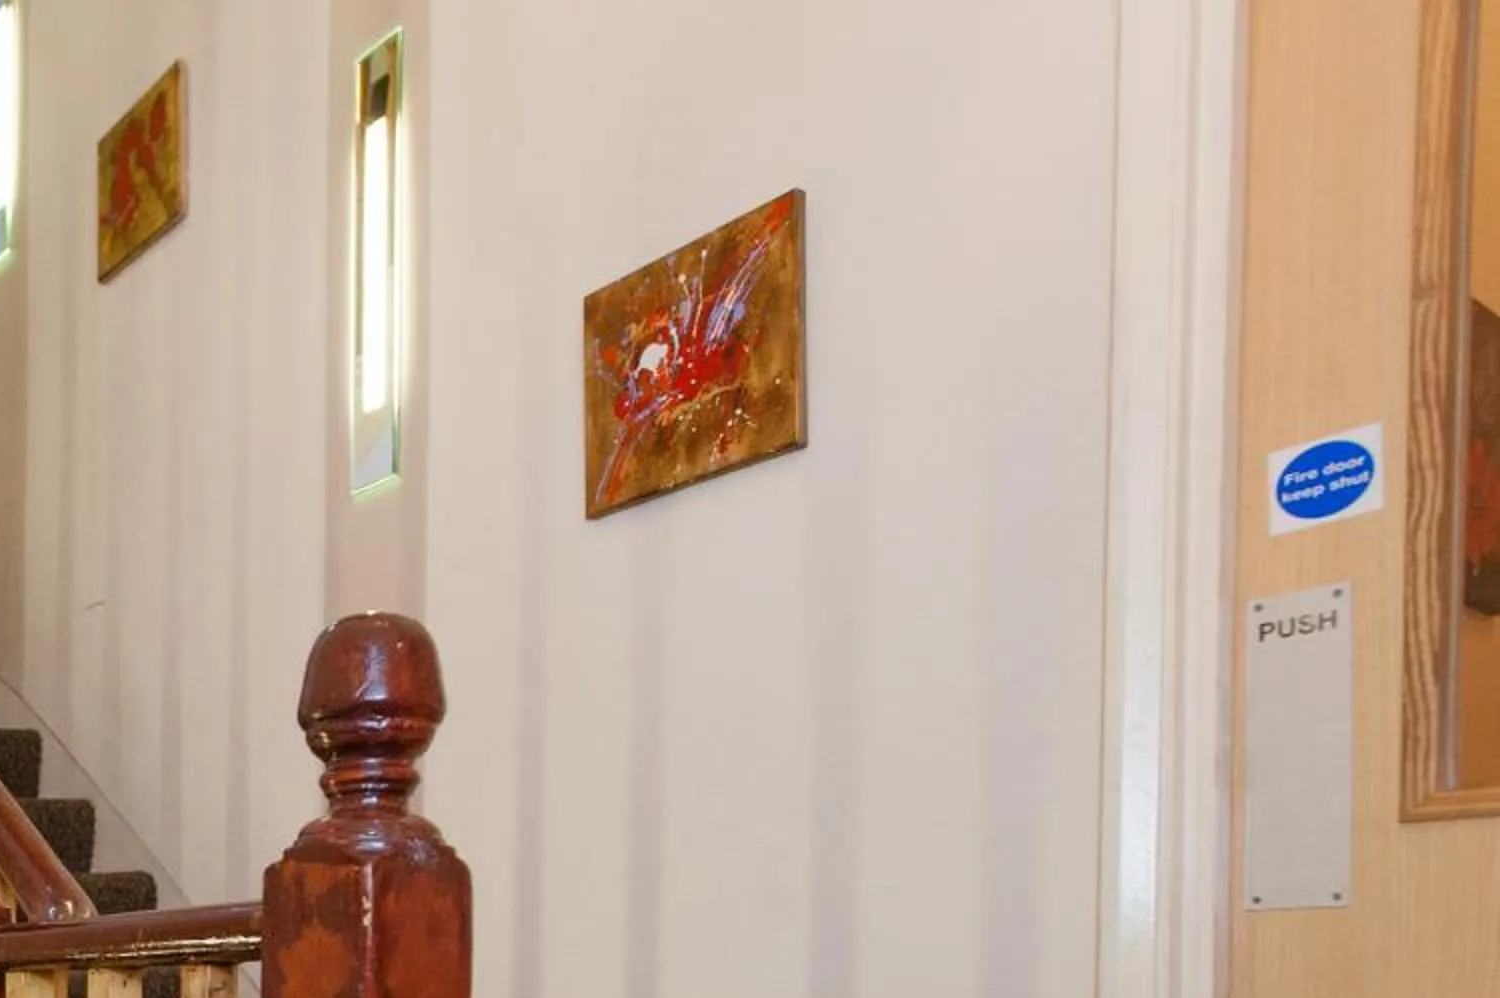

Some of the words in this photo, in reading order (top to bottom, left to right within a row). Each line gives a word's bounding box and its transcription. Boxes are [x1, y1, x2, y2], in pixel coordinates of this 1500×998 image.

[1281, 485, 1325, 503] keep
[1329, 470, 1369, 491] shut
[1283, 469, 1318, 487] Fire
[1322, 455, 1367, 475] door
[1258, 609, 1337, 642] PUSH
